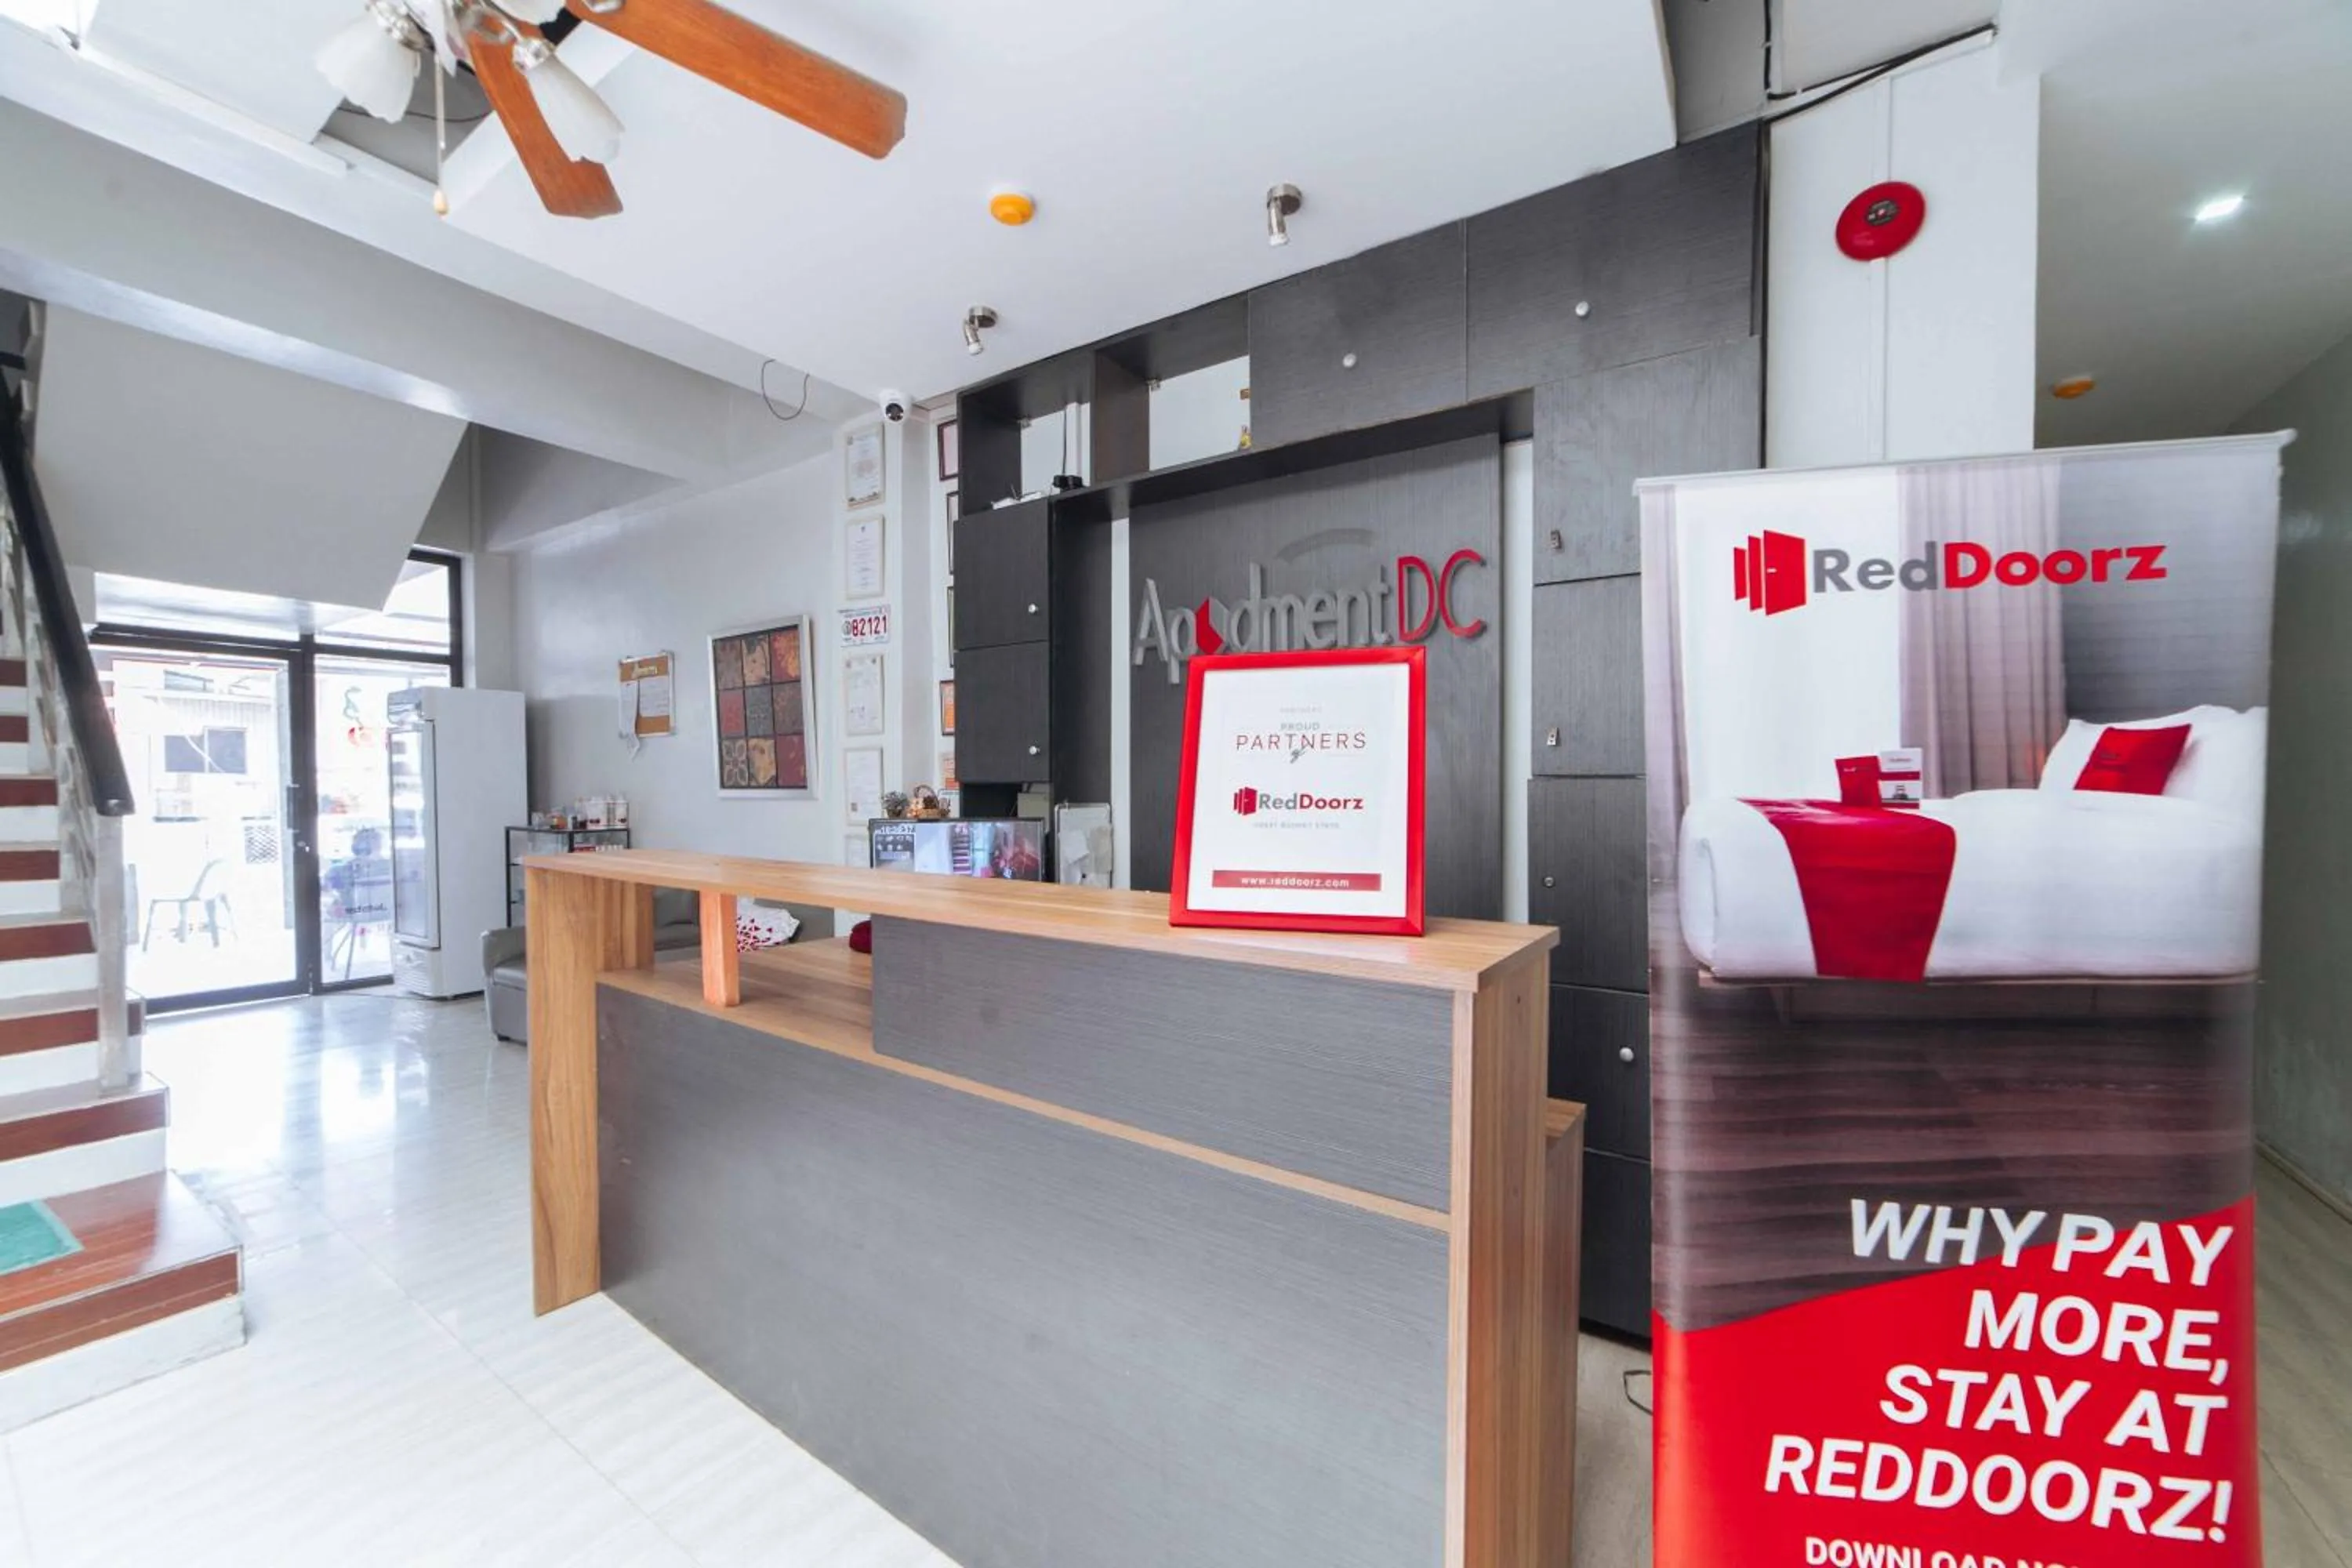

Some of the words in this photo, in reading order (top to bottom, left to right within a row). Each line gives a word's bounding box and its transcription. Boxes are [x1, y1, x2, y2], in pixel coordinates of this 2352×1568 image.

[1813, 540, 2168, 593] RedDoorz
[852, 615, 887, 637] 82121
[1236, 732, 1367, 750] PARTNERS
[1280, 722, 1320, 731] PROUD
[1259, 793, 1364, 810] RedDoorz
[1851, 1198, 2046, 1268] WHY
[2053, 1213, 2234, 1287] PAY
[1964, 1289, 2229, 1385] MORE,
[1879, 1363, 2092, 1438] STAY
[2104, 1389, 2228, 1456] AT
[1763, 1435, 2232, 1544] REDDOORZ!
